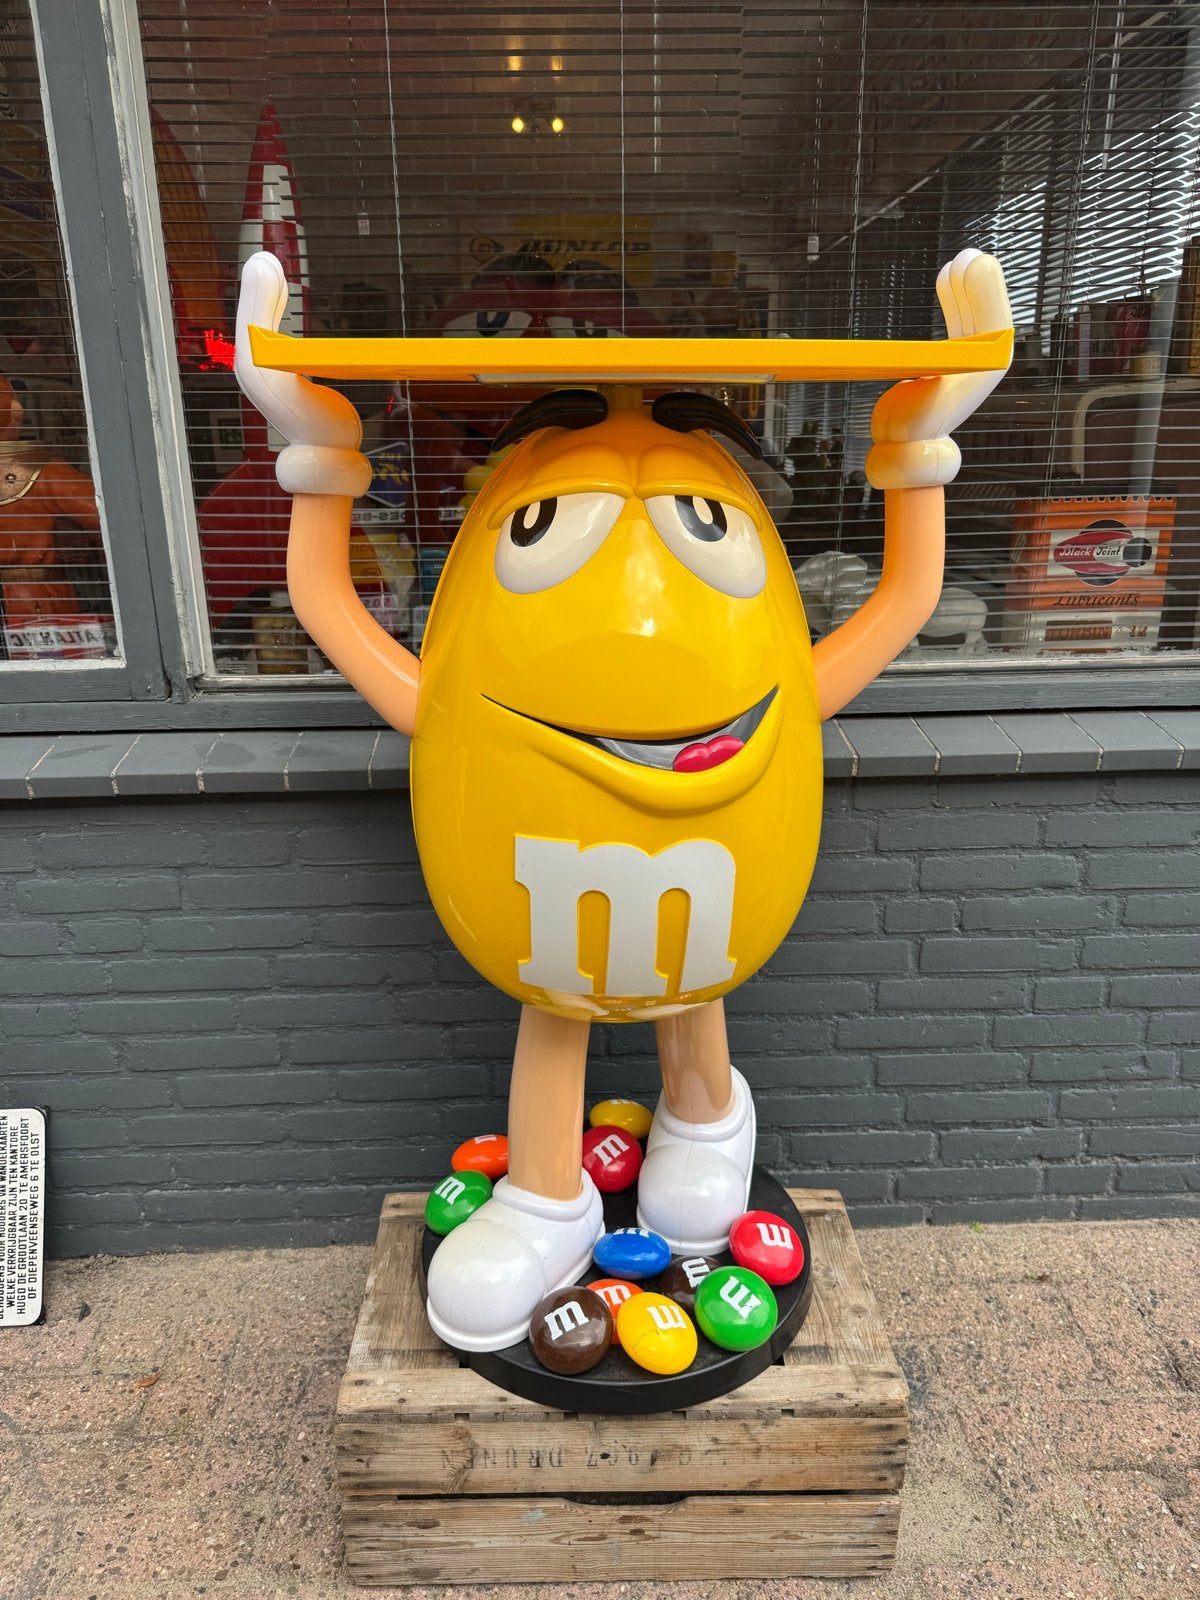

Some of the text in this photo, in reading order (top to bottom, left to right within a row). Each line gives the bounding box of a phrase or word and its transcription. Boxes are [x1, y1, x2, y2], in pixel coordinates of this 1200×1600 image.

[517, 239, 650, 256] DUNLOP
[1060, 544, 1091, 556] Black
[1053, 590, 1141, 607] Lubricants
[515, 834, 737, 996] m
[31, 1132, 39, 1156] OLST
[592, 1134, 630, 1167] m
[30, 1160, 39, 1171] TE
[435, 1176, 466, 1205] m
[6, 1126, 18, 1308] WELKE VERKRIJGBAAR ZIJN TEN KANTORE
[17, 1117, 29, 1314] HUGO DE GROOTLAAN 20 TE AMERSFOORT
[28, 1186, 38, 1283] DIEPENVEENSEWEG
[28, 1286, 36, 1299] OF
[544, 1300, 589, 1341] m
